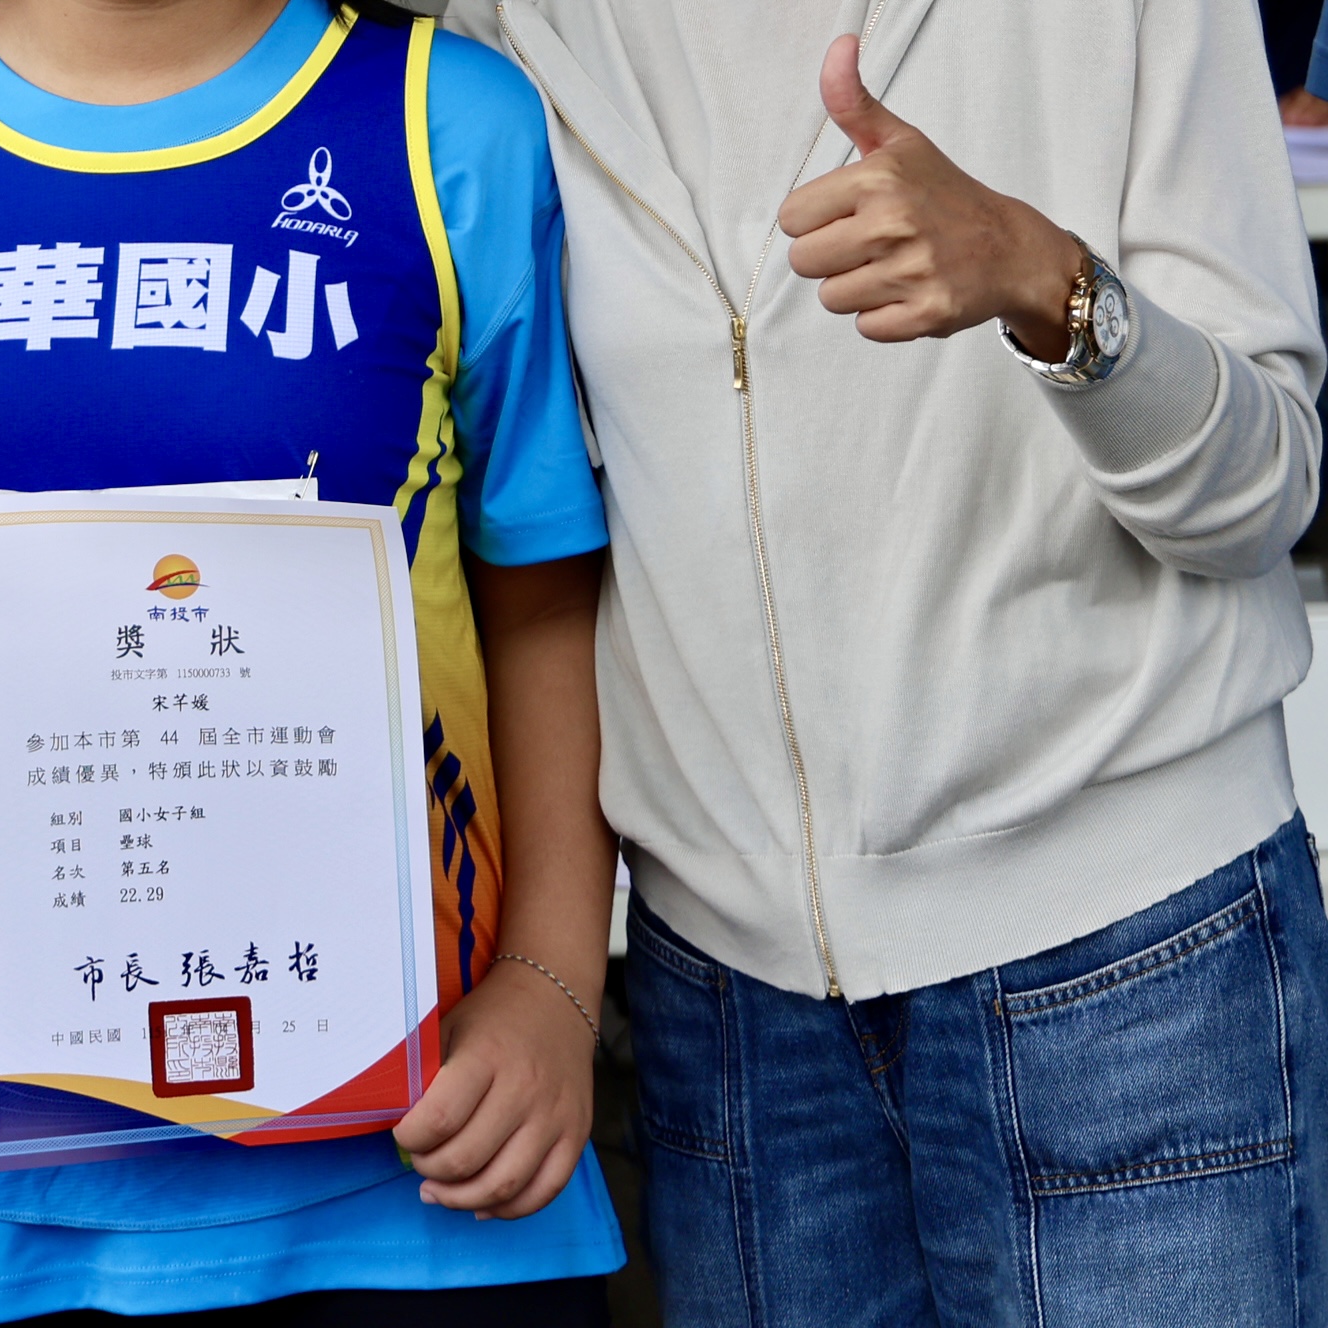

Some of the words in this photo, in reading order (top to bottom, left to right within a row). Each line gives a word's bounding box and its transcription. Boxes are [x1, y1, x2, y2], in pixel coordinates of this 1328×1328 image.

[271, 211, 359, 248] HODARLA
[146, 604, 210, 623] 南投市
[115, 624, 246, 659] 獎狀
[111, 668, 168, 681] 投市文字第
[177, 668, 231, 679] 1150000733
[239, 666, 252, 679] 號
[152, 692, 210, 712] 宋芊媛
[26, 729, 141, 754] 參加本市第
[160, 729, 179, 746] 44
[198, 725, 337, 747] 屆全市運動會
[50, 810, 83, 827] 組別
[119, 805, 207, 823] 國小女子組
[50, 838, 82, 855] 項目
[120, 833, 154, 851] 壘球
[51, 863, 86, 881] 名次
[121, 860, 170, 878] 第五名
[52, 890, 87, 909] 成績
[120, 886, 165, 903] 22.29
[282, 1020, 296, 1033] 25
[317, 1019, 329, 1033] 日
